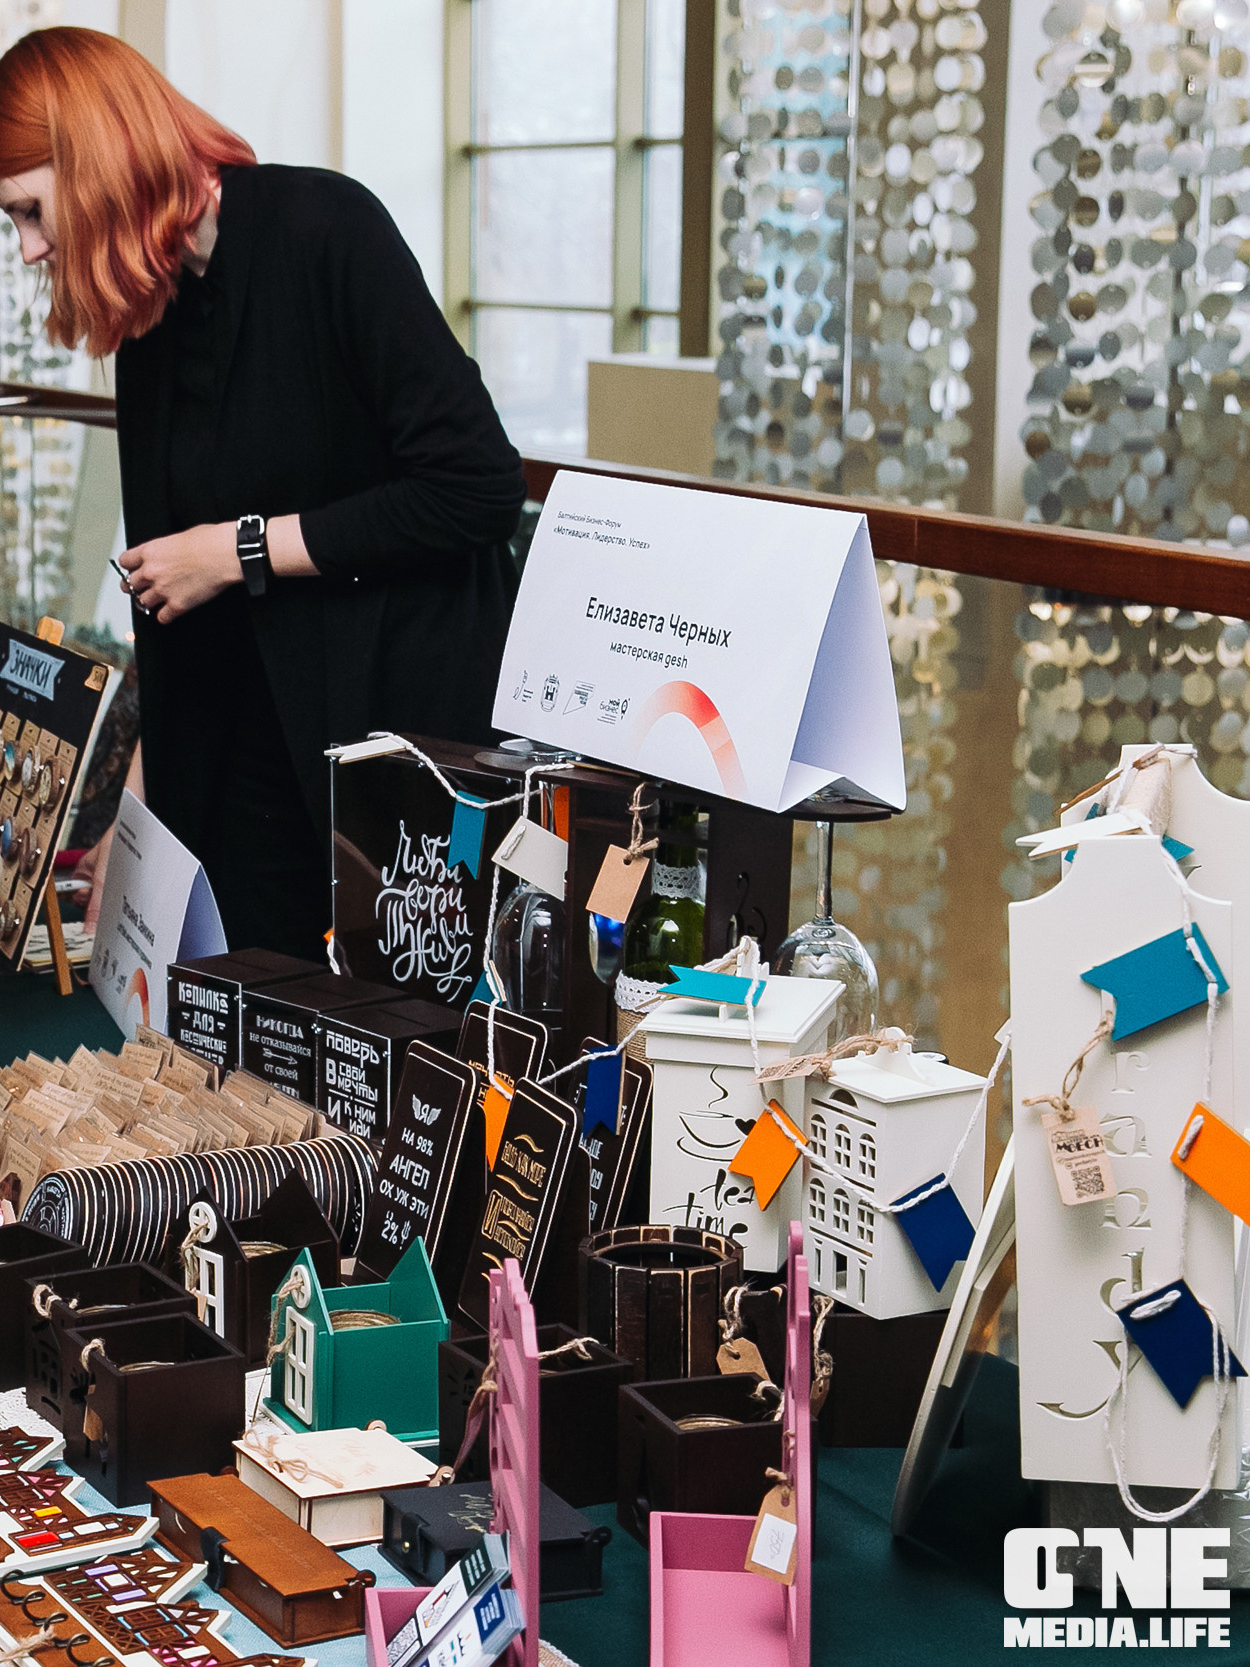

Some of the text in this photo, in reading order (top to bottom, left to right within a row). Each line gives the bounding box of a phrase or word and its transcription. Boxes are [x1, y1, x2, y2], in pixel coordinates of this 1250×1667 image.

[585, 596, 732, 648] Елизавета Черных
[10, 649, 52, 689] ЗНАЧКИ
[609, 641, 688, 669] мастерская gesh
[178, 981, 229, 1015] КОПИЛКА
[192, 1010, 215, 1034] ДЛЯ
[249, 1032, 312, 1058] не отказывайся
[264, 1063, 299, 1081] от своей
[325, 1057, 337, 1085] В
[327, 1096, 341, 1125] И
[344, 1101, 352, 1117] К
[401, 1127, 433, 1157] НА 98%
[389, 1153, 431, 1190] АНГЕЛ
[379, 1178, 430, 1220] ОХ УЖ ЭТИ
